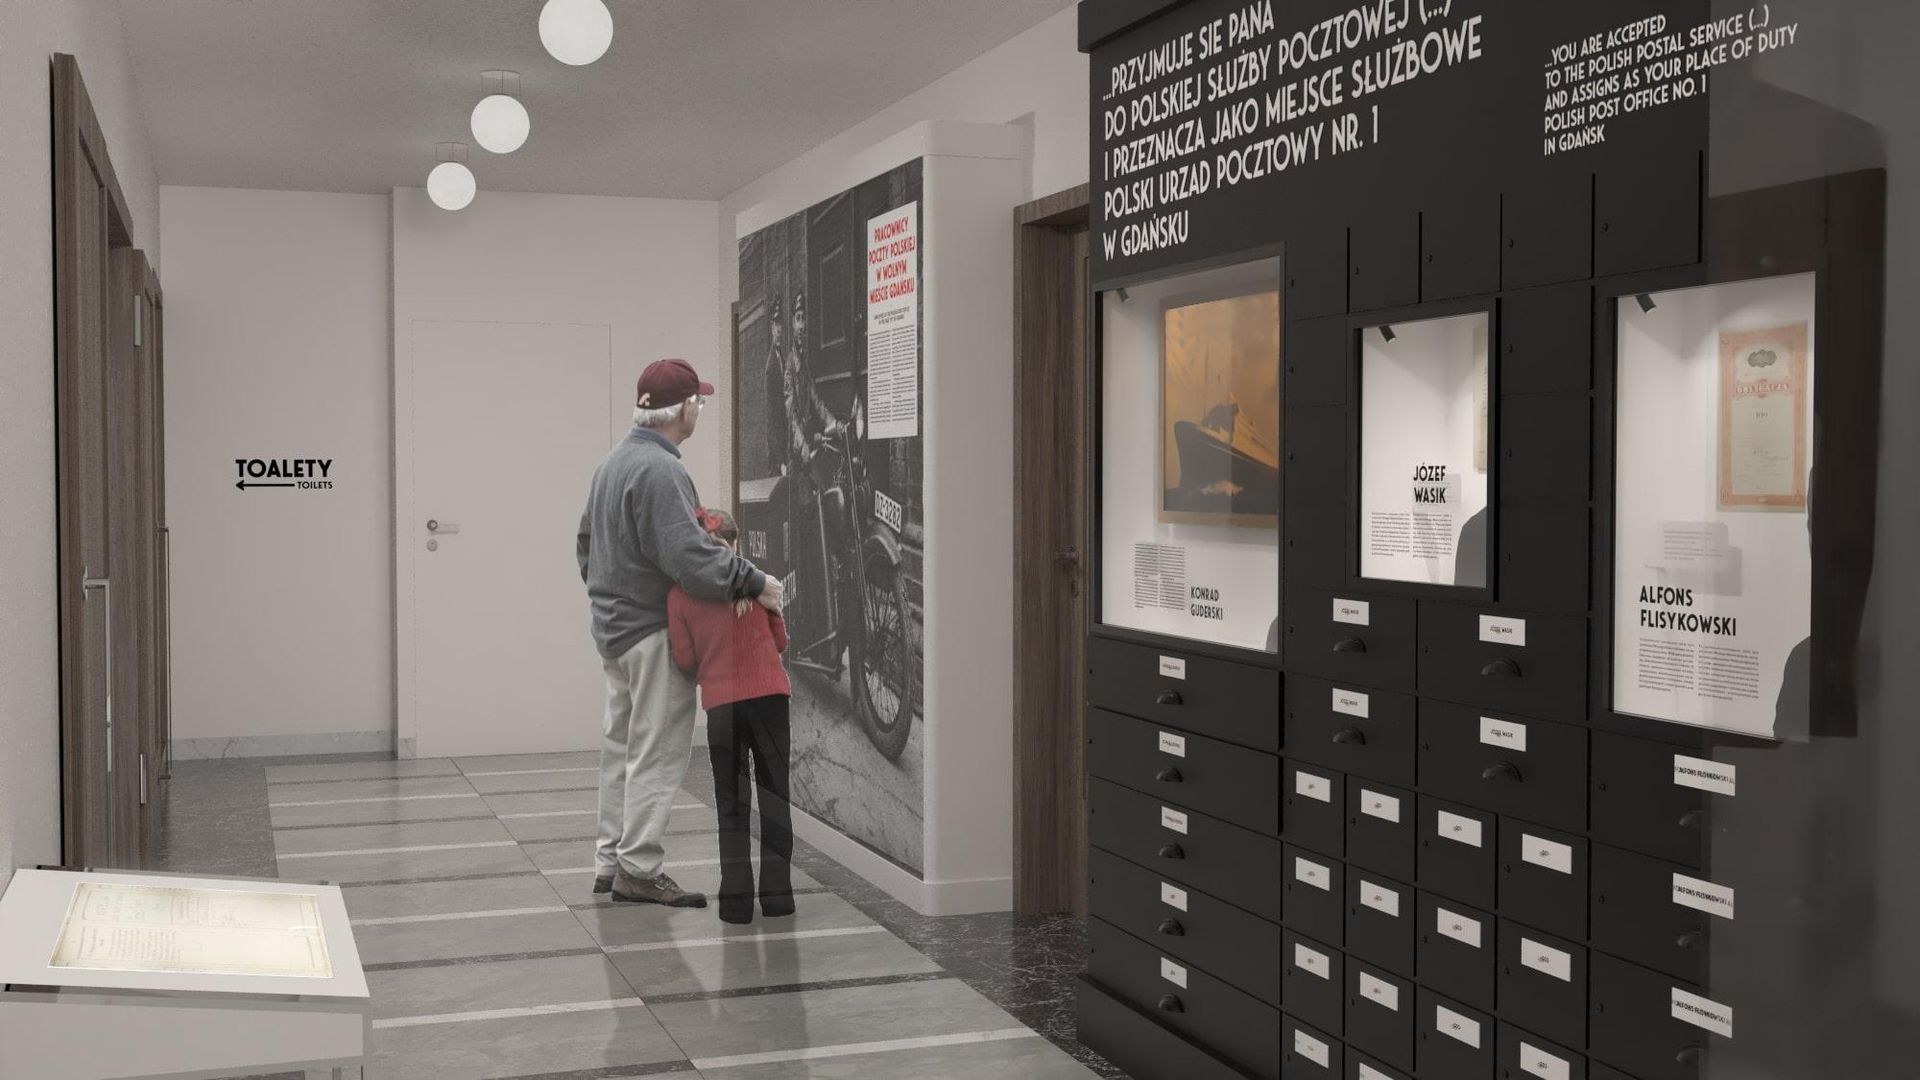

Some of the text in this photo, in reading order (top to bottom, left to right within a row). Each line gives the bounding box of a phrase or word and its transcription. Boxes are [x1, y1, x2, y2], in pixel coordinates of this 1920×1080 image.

[1102, 0, 1275, 101] ...PRZYJMUJE SIE PANA
[1544, 14, 1667, 68] ...YOU ARE ACCEPTED
[1545, 4, 1770, 89] TO THE POLISH POSTAL SERVICE (...)
[1105, 104, 1127, 141] DO
[1131, 73, 1202, 131] POLSKIEJ
[1208, 44, 1272, 102] SŁUŻBY
[1279, 0, 1409, 75] POCZTOWEJ
[1544, 23, 1798, 112] AND ASSIGNS AS YOUR PLACE OF DUTY
[1104, 15, 1482, 181] I PRZEZNACZA JAKO MIEJSCE SŁUŻBOWE
[1544, 74, 1706, 134] POLISH POST OFFICE NO. 1
[1544, 124, 1606, 156] IN GDAŃSK
[1104, 105, 1378, 222] POLSKI URZAD POCZTOWY NR. 1
[874, 216, 909, 243] PRACOWNICY
[1103, 209, 1189, 261] W GDAŃSKU
[869, 235, 915, 266] POCZTY POLSKIEJ
[876, 259, 907, 283] W WOLNYM
[235, 458, 333, 478] TOALETY
[1413, 462, 1446, 482] JÓZEF
[297, 481, 334, 490] TOILETS
[1413, 487, 1446, 504] WASIK
[1190, 586, 1220, 602] KONRAD
[1639, 584, 1694, 607] ALFONS
[1190, 603, 1223, 620] GUDERSKI
[1640, 608, 1737, 637] FLISYKOWSKI
